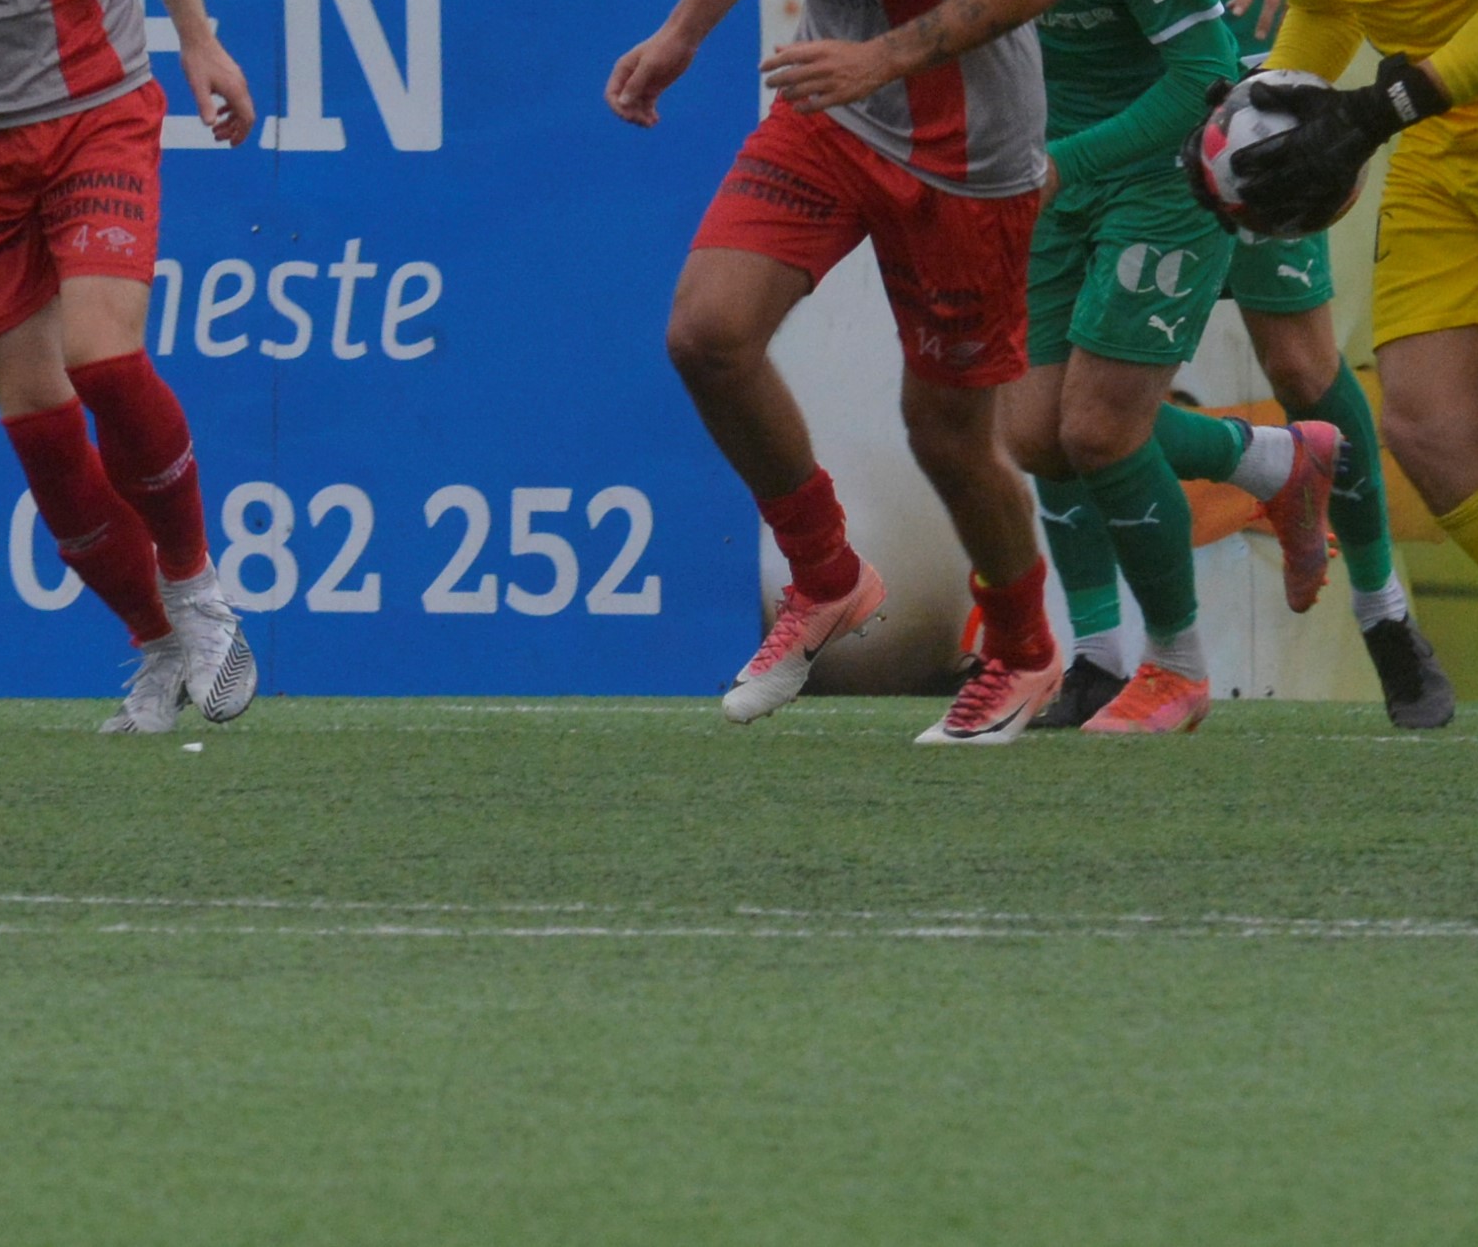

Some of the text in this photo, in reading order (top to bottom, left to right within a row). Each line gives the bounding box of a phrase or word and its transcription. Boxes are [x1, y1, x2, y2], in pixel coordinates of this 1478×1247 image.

[72, 224, 90, 254] 4
[916, 327, 941, 362] 14
[219, 480, 382, 615] 82
[421, 482, 662, 618] 252
